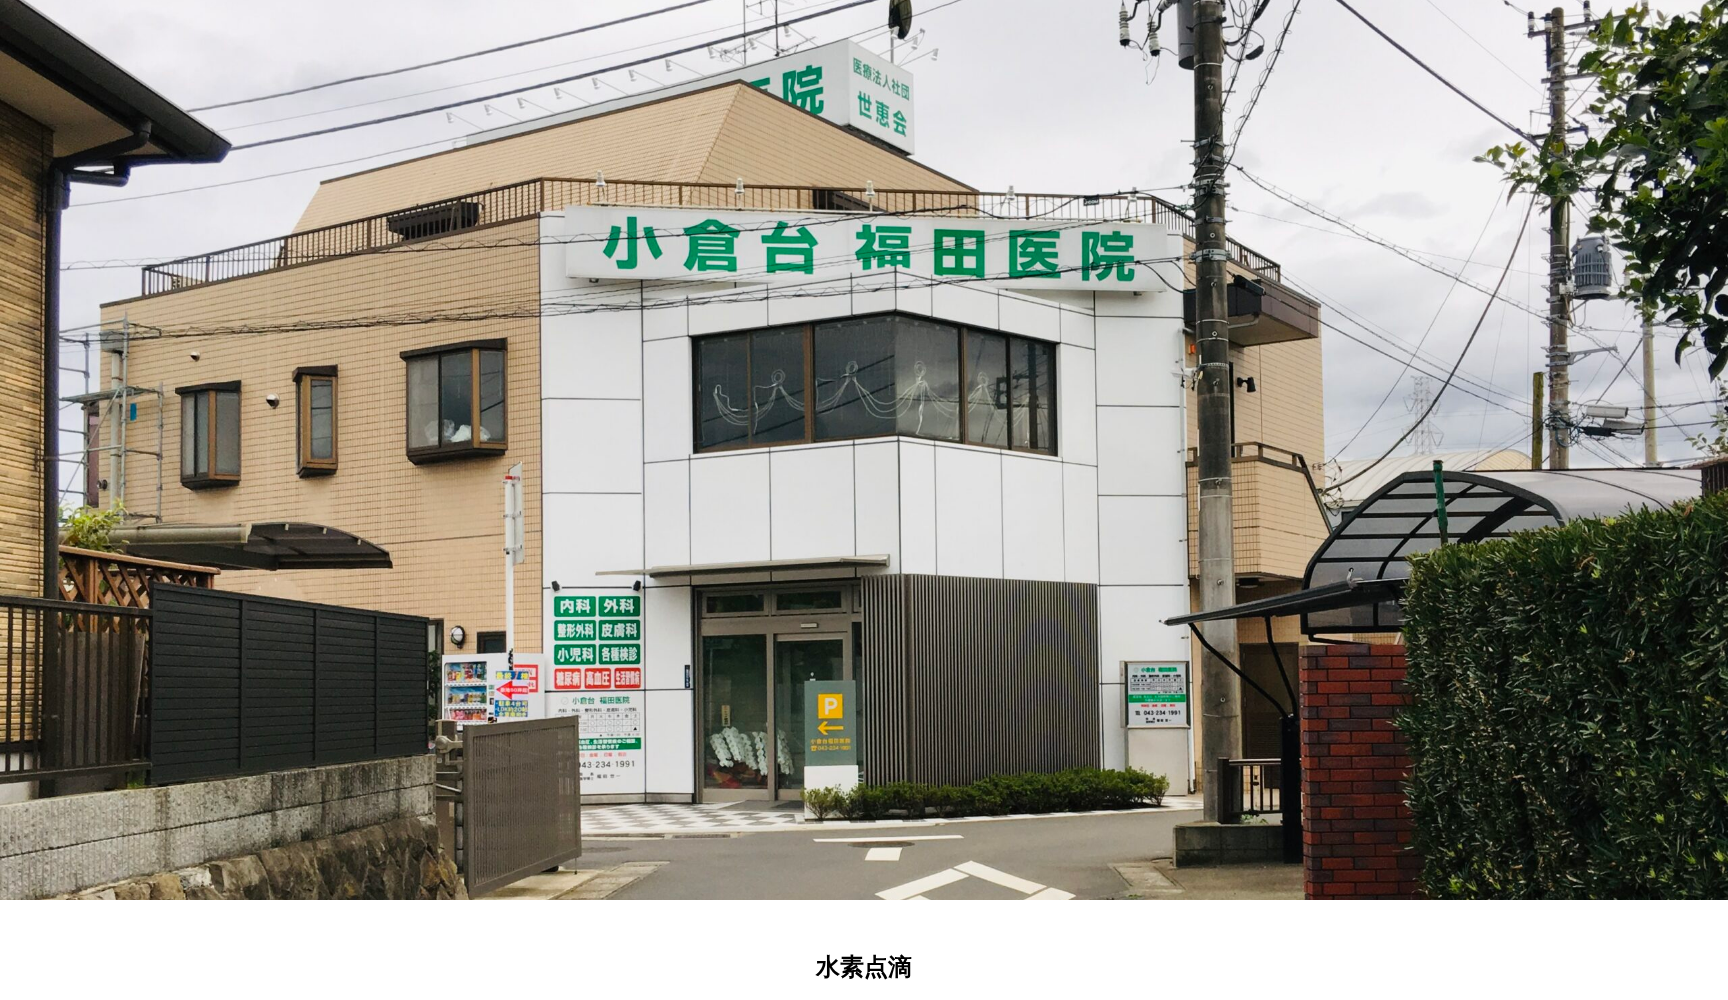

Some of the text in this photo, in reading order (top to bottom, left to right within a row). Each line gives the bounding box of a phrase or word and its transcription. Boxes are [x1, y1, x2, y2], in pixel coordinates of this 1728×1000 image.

[853, 57, 910, 101] 医療法人社団
[857, 90, 907, 137] 世恵会
[603, 216, 1136, 283] 小倉台 福田医院
[560, 598, 591, 614] 内科
[603, 598, 634, 614] 外科
[557, 623, 594, 638] 整形外科
[601, 623, 637, 638] 皮膚科
[557, 647, 593, 662] 小児科
[601, 647, 637, 662] 各種検診
[555, 671, 580, 686] 糖尿病
[585, 671, 610, 686] 高血圧
[824, 697, 838, 715] P
